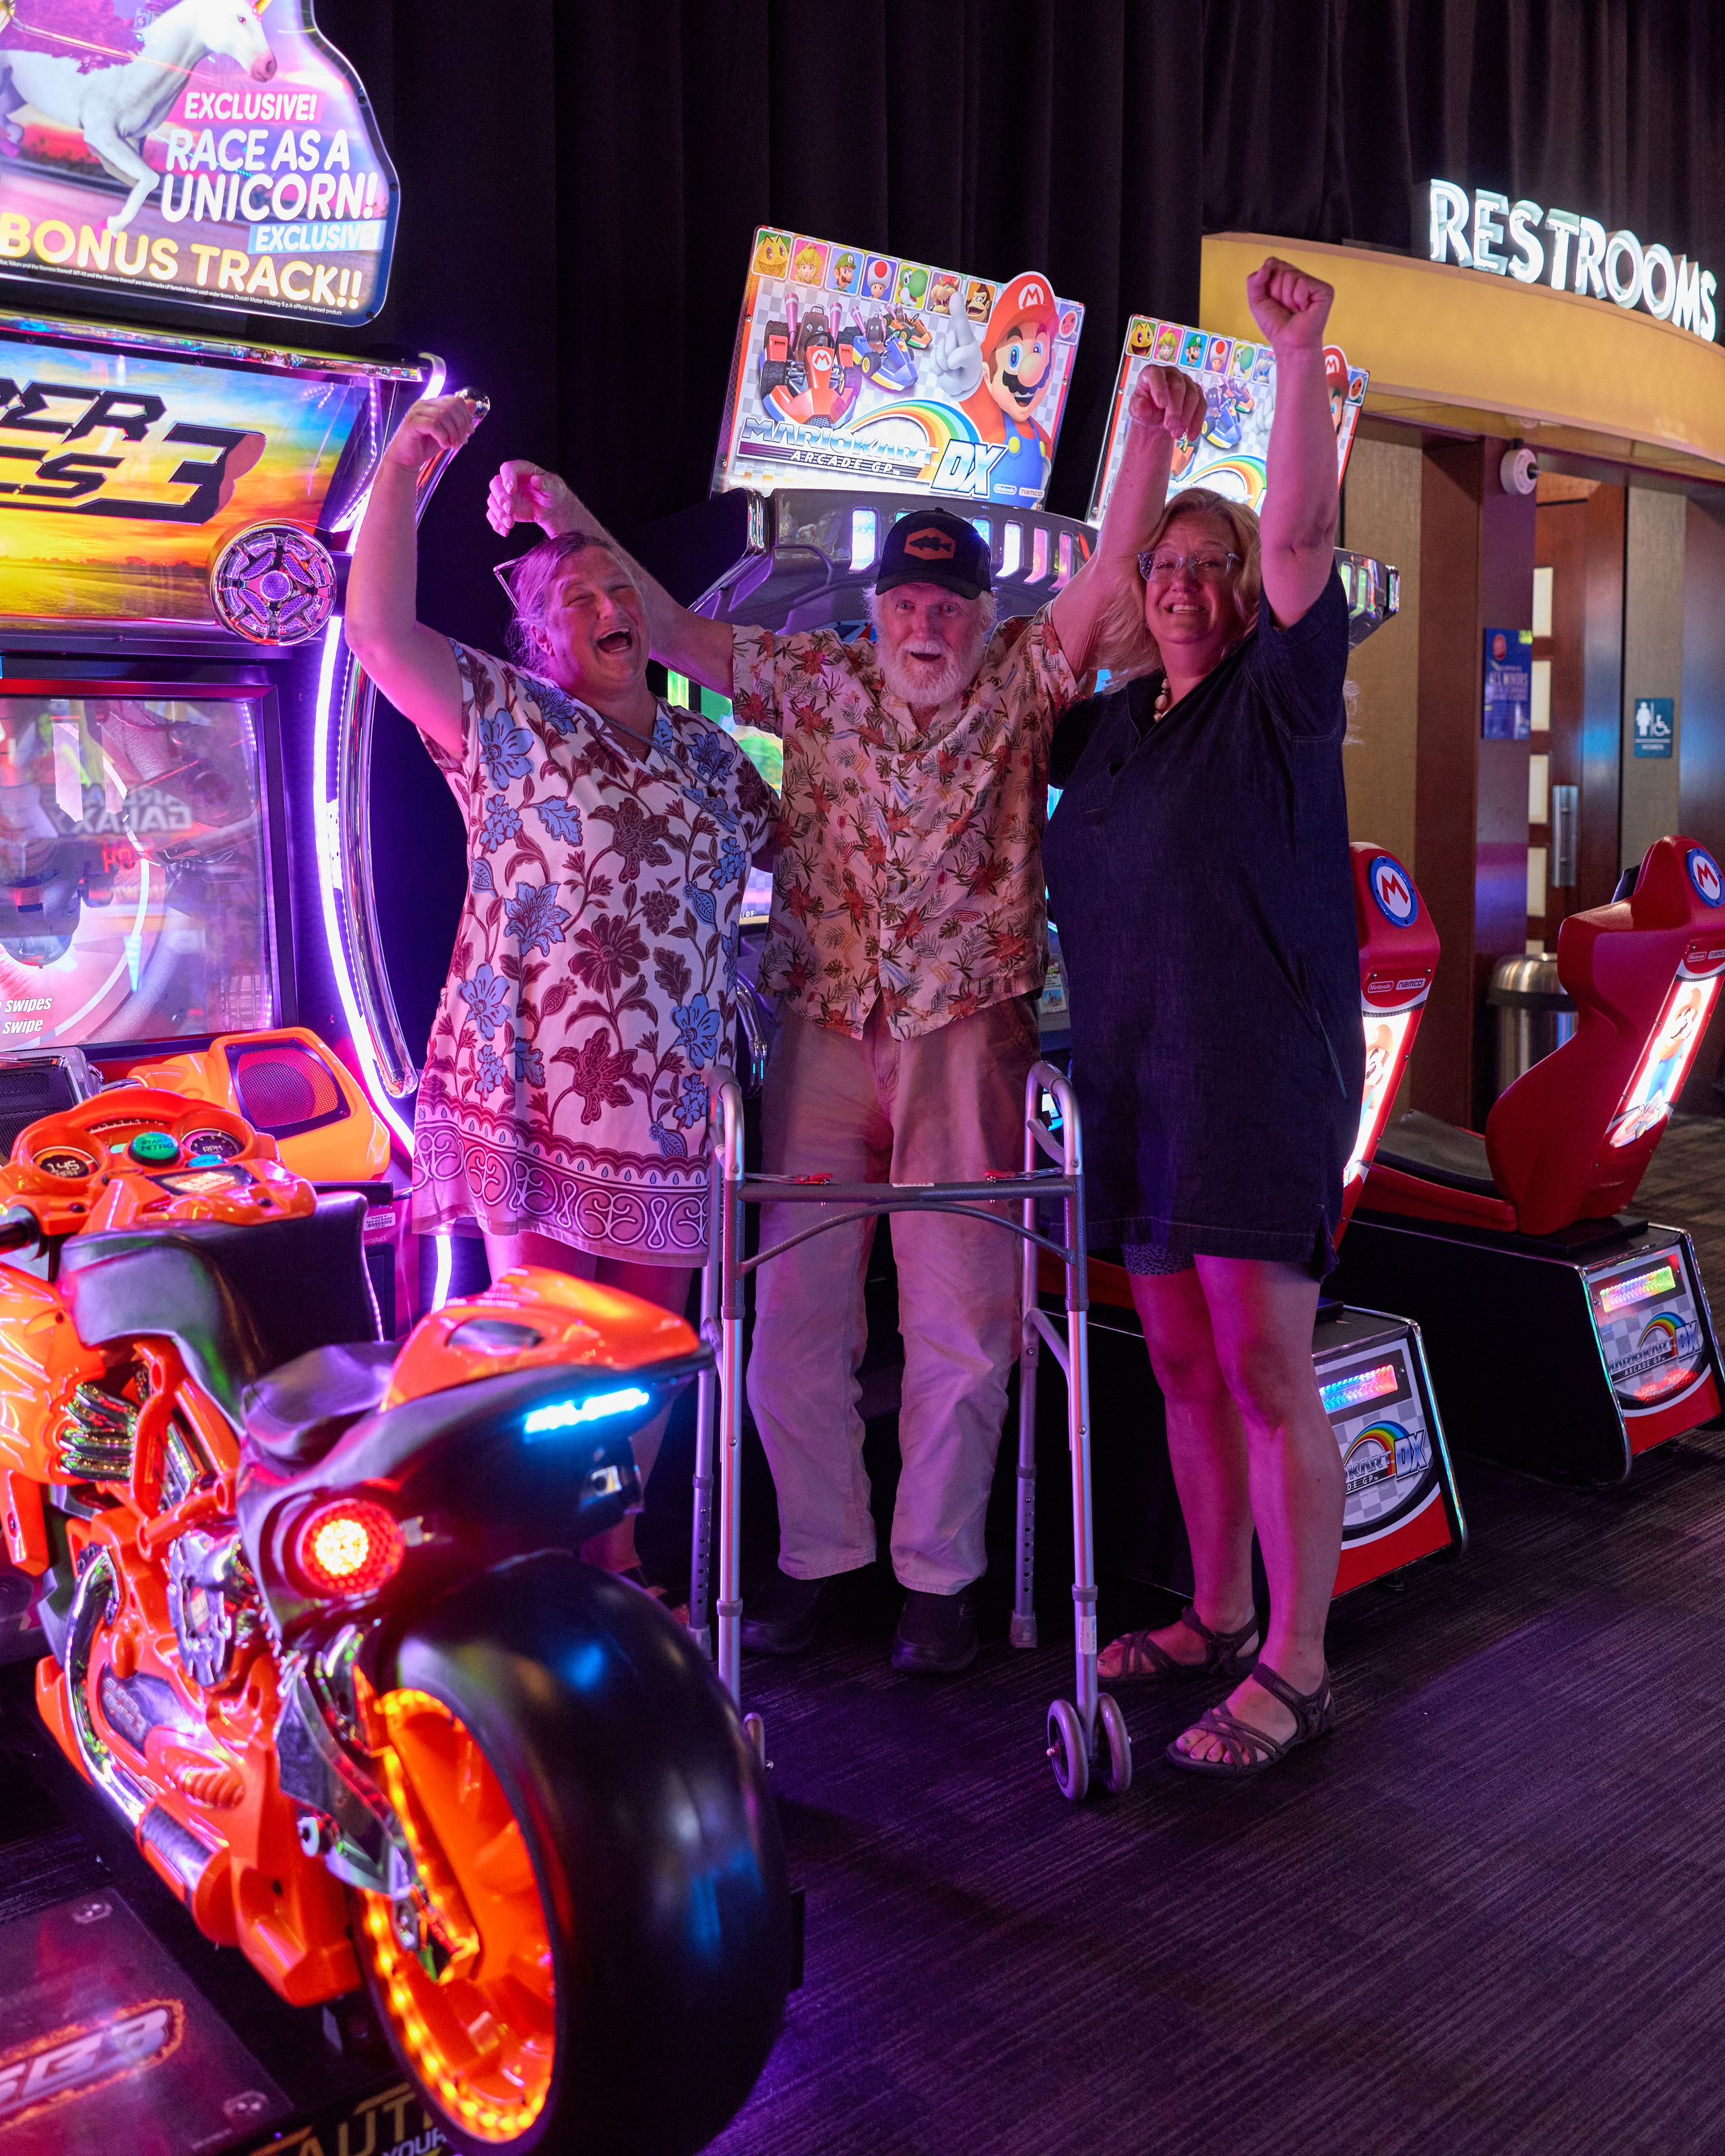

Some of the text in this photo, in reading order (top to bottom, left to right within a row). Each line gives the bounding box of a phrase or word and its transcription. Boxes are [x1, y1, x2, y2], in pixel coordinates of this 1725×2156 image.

[185, 92, 317, 121] EXCLUSIVE!
[166, 128, 350, 171] RACE AS A
[161, 172, 377, 222] UNICORN!
[255, 223, 381, 252] EXCLUSIVE!
[0, 212, 363, 309] BONUS TRACK!!
[1429, 178, 1718, 342] RESTROOMS
[235, 294, 249, 302] Ducati
[250, 296, 263, 305] Motor
[264, 298, 280, 308] Holding
[790, 450, 862, 470] ARCADE
[931, 438, 1007, 497] DX
[1020, 488, 1043, 497] namco
[1369, 980, 1424, 991] Nintendo namco
[142, 1143, 174, 1151] NITRO
[202, 1145, 223, 1153] RPM
[1675, 1319, 1701, 1361] DX
[1624, 1360, 1651, 1376] ARCADE
[1393, 1428, 1429, 1480] DX
